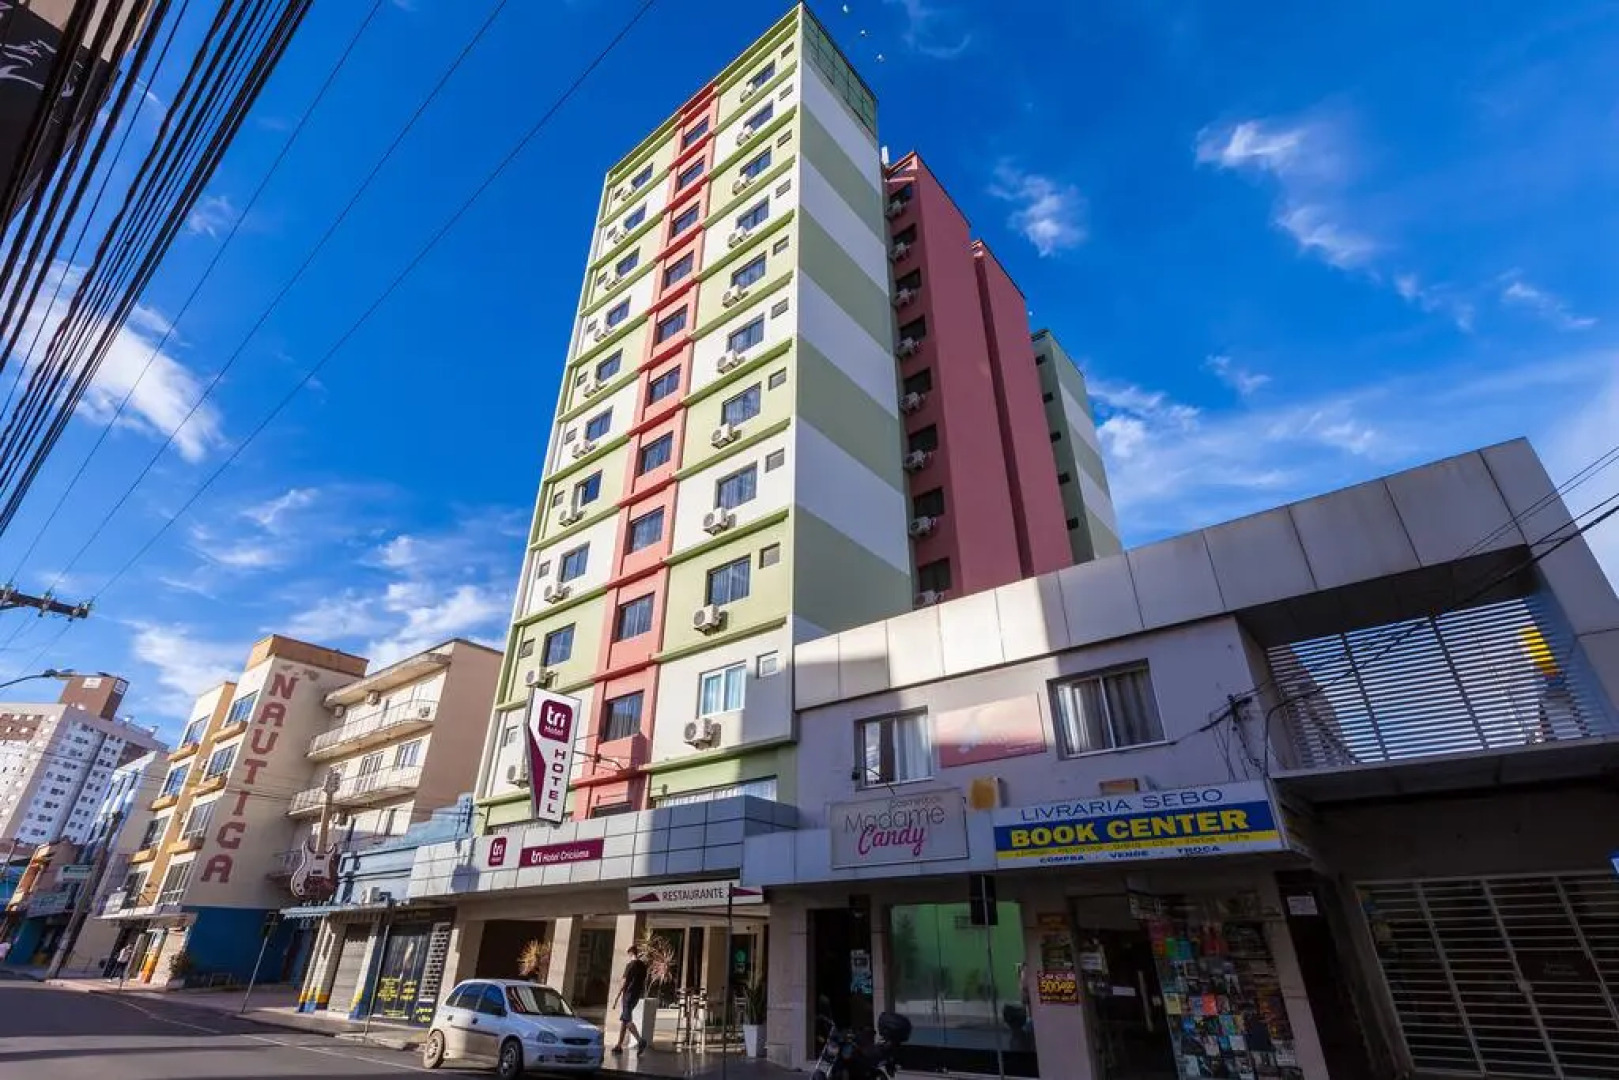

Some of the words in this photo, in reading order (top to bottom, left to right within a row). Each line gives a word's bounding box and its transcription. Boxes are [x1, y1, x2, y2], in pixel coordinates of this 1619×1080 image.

[546, 705, 566, 728] tri
[547, 749, 566, 814] HOTEL
[844, 800, 945, 833] Madame
[1021, 799, 1132, 821] LIVRARIA
[1143, 788, 1223, 809] SEBO
[858, 823, 924, 856] Candy
[1011, 820, 1098, 847] BOOK
[1107, 809, 1249, 840] CENTER
[1040, 854, 1084, 863] COMPRA
[1177, 845, 1221, 855] TROCA
[662, 887, 724, 901] RESTAURANTE
